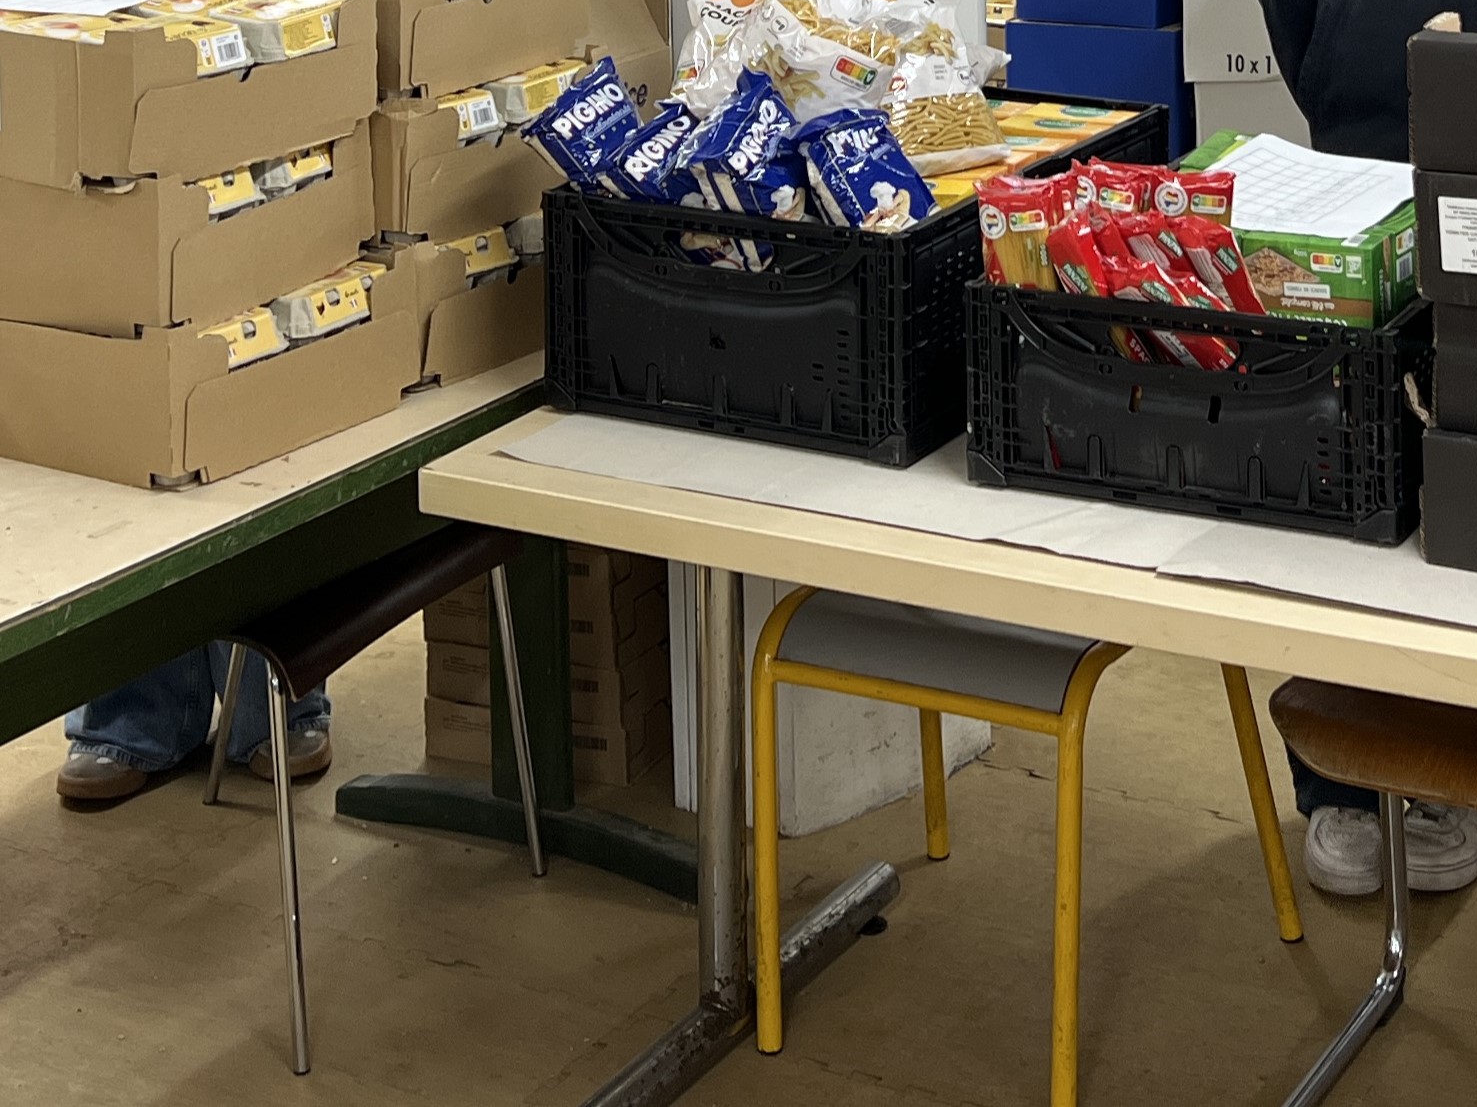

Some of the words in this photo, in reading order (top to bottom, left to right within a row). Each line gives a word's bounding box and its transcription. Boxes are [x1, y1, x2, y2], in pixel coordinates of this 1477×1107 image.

[1226, 53, 1245, 73] 10
[1249, 60, 1259, 74] x
[1265, 55, 1271, 74] 1
